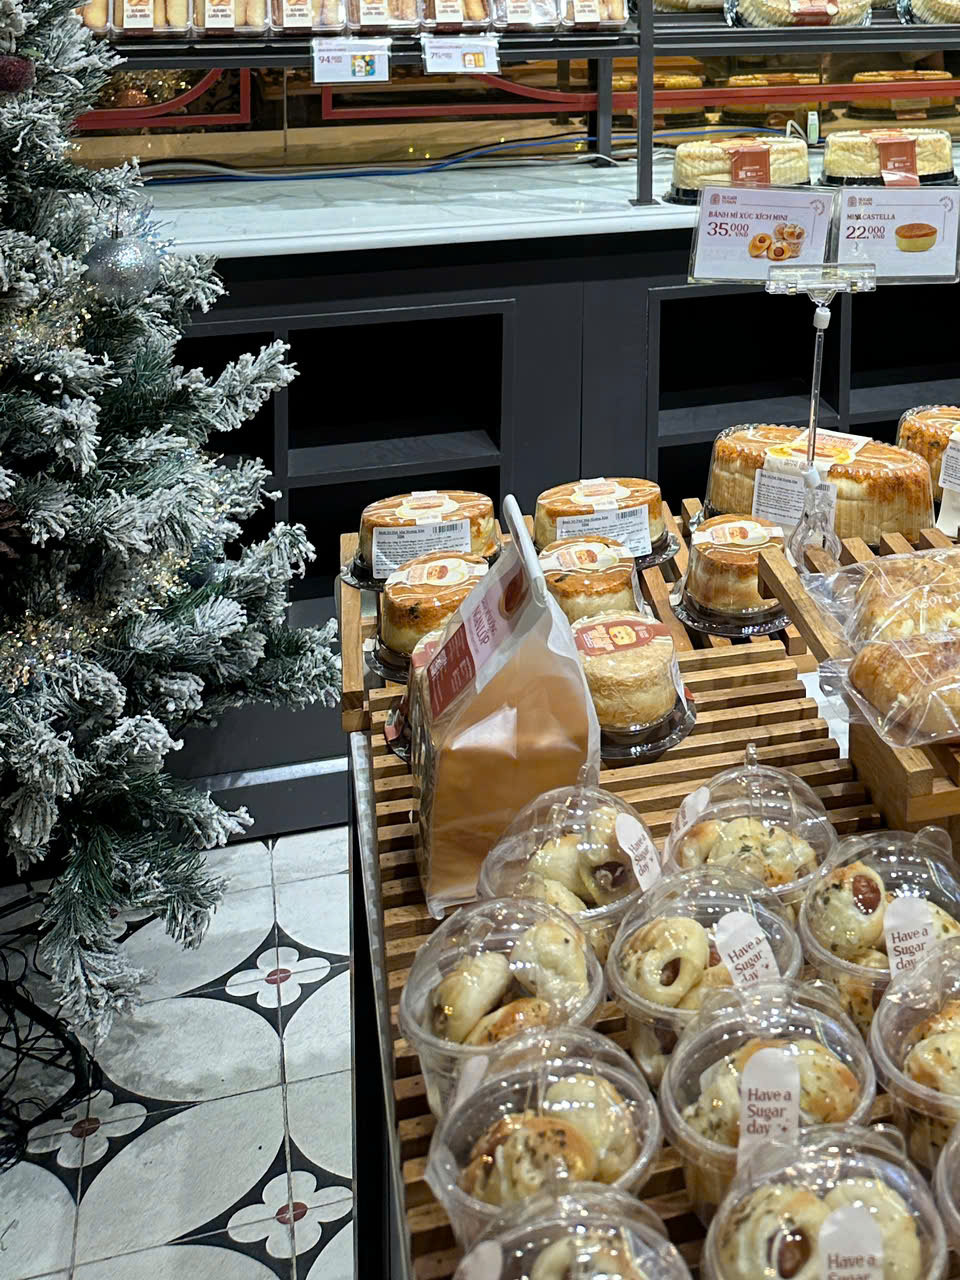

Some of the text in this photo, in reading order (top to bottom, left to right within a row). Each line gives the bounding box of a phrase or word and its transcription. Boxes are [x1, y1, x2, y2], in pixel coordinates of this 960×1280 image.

[707, 221, 749, 238] 35.000
[846, 225, 885, 239] 22.000
[891, 927, 929, 945] Have a
[728, 941, 753, 964] Have
[893, 941, 927, 958] Sugar
[734, 949, 763, 976] Sugar
[895, 957, 917, 971] day
[747, 1087, 792, 1102] Have a
[747, 1103, 787, 1121] Sugar
[746, 1118, 771, 1138] day
[827, 1252, 865, 1270] Have
[827, 1271, 872, 1280] Sugar
